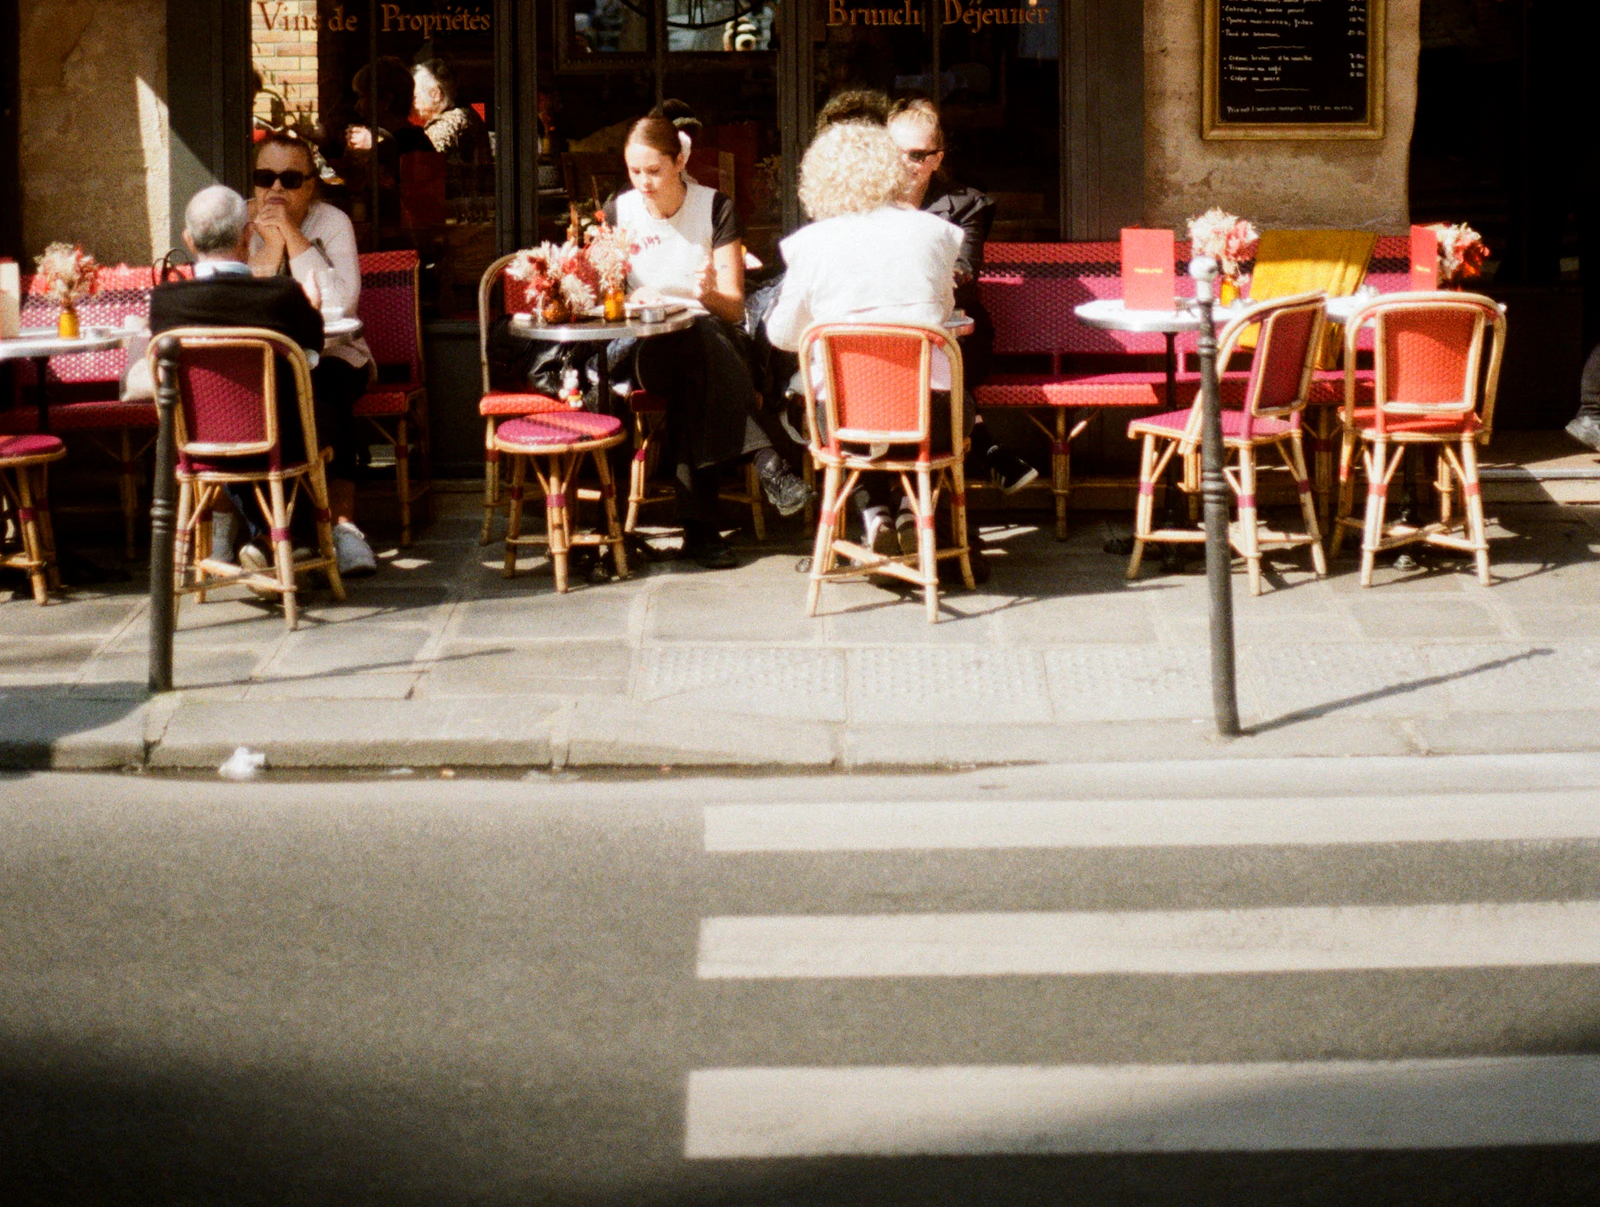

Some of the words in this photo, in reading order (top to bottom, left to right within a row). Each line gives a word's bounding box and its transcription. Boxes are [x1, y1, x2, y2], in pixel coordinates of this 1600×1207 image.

[257, 0, 321, 32] Vins
[328, 5, 359, 32] de
[381, 2, 491, 40] Propriétés
